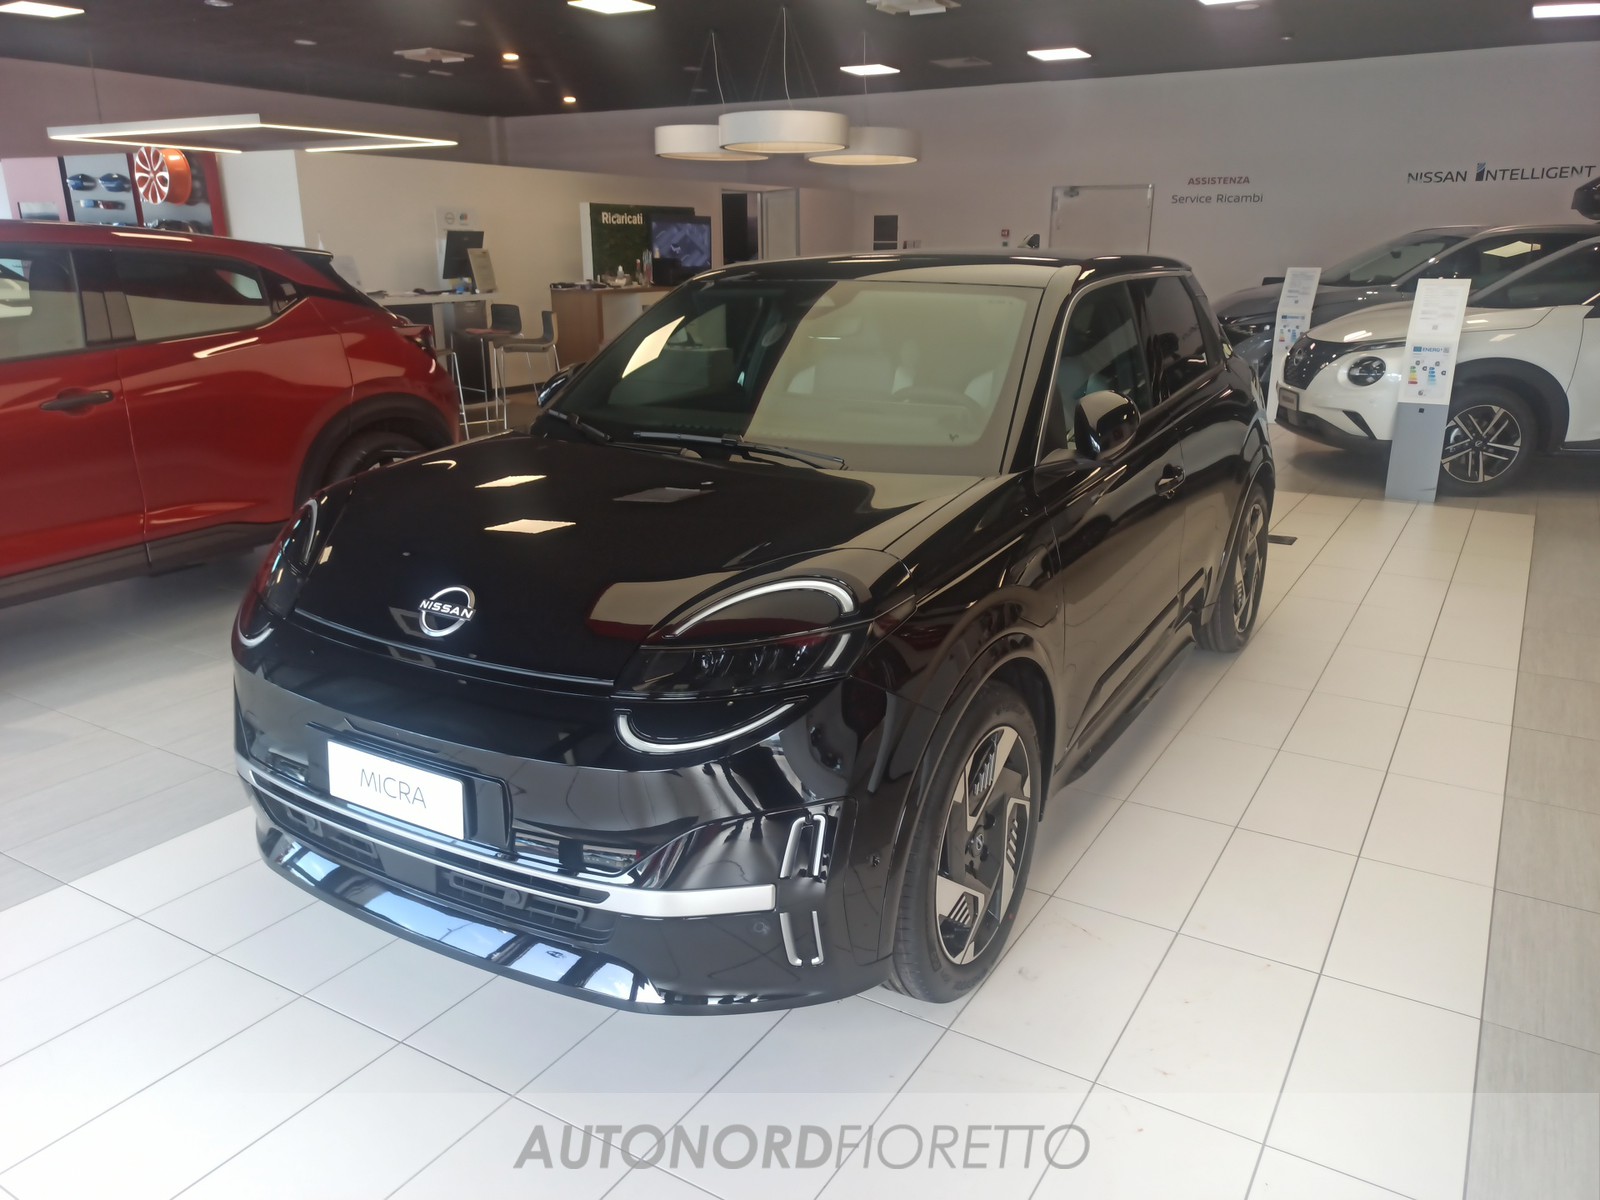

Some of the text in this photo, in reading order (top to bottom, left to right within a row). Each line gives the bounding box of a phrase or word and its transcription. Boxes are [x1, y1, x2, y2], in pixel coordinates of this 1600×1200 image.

[1187, 176, 1250, 185] ASSISTENZA
[1407, 162, 1596, 184] NISSAN INTELLIGENT
[1171, 193, 1264, 204] Service Ricambi
[601, 211, 643, 224] Ricaricati
[419, 598, 474, 619] NISSAN
[359, 767, 427, 809] MICRA
